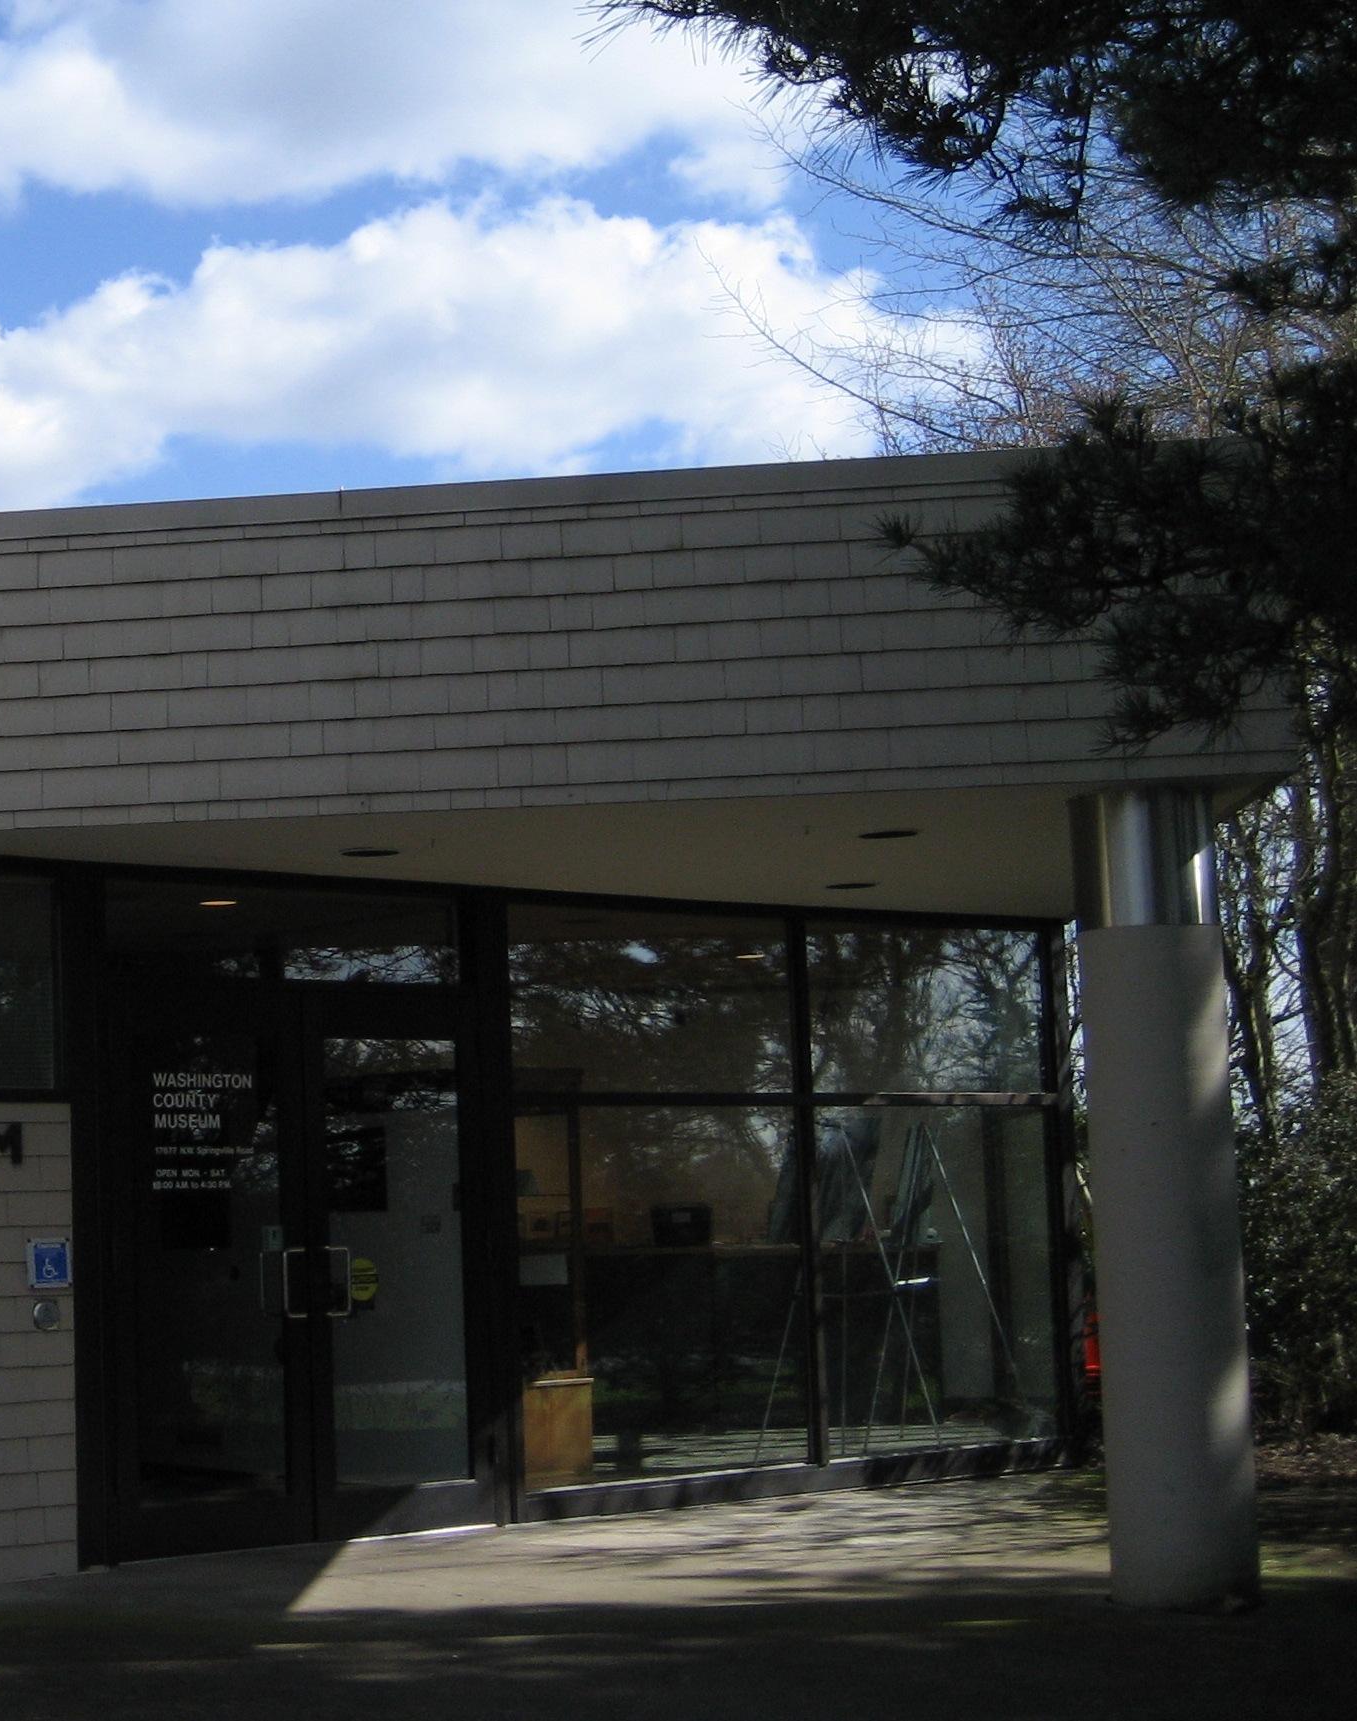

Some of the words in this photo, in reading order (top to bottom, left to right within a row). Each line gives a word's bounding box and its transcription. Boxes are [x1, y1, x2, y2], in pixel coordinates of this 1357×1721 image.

[153, 1072, 252, 1089] WASHINGTON
[153, 1092, 216, 1108] COUNTY
[154, 1113, 221, 1129] MUSEUM
[155, 1168, 178, 1178] OPEN
